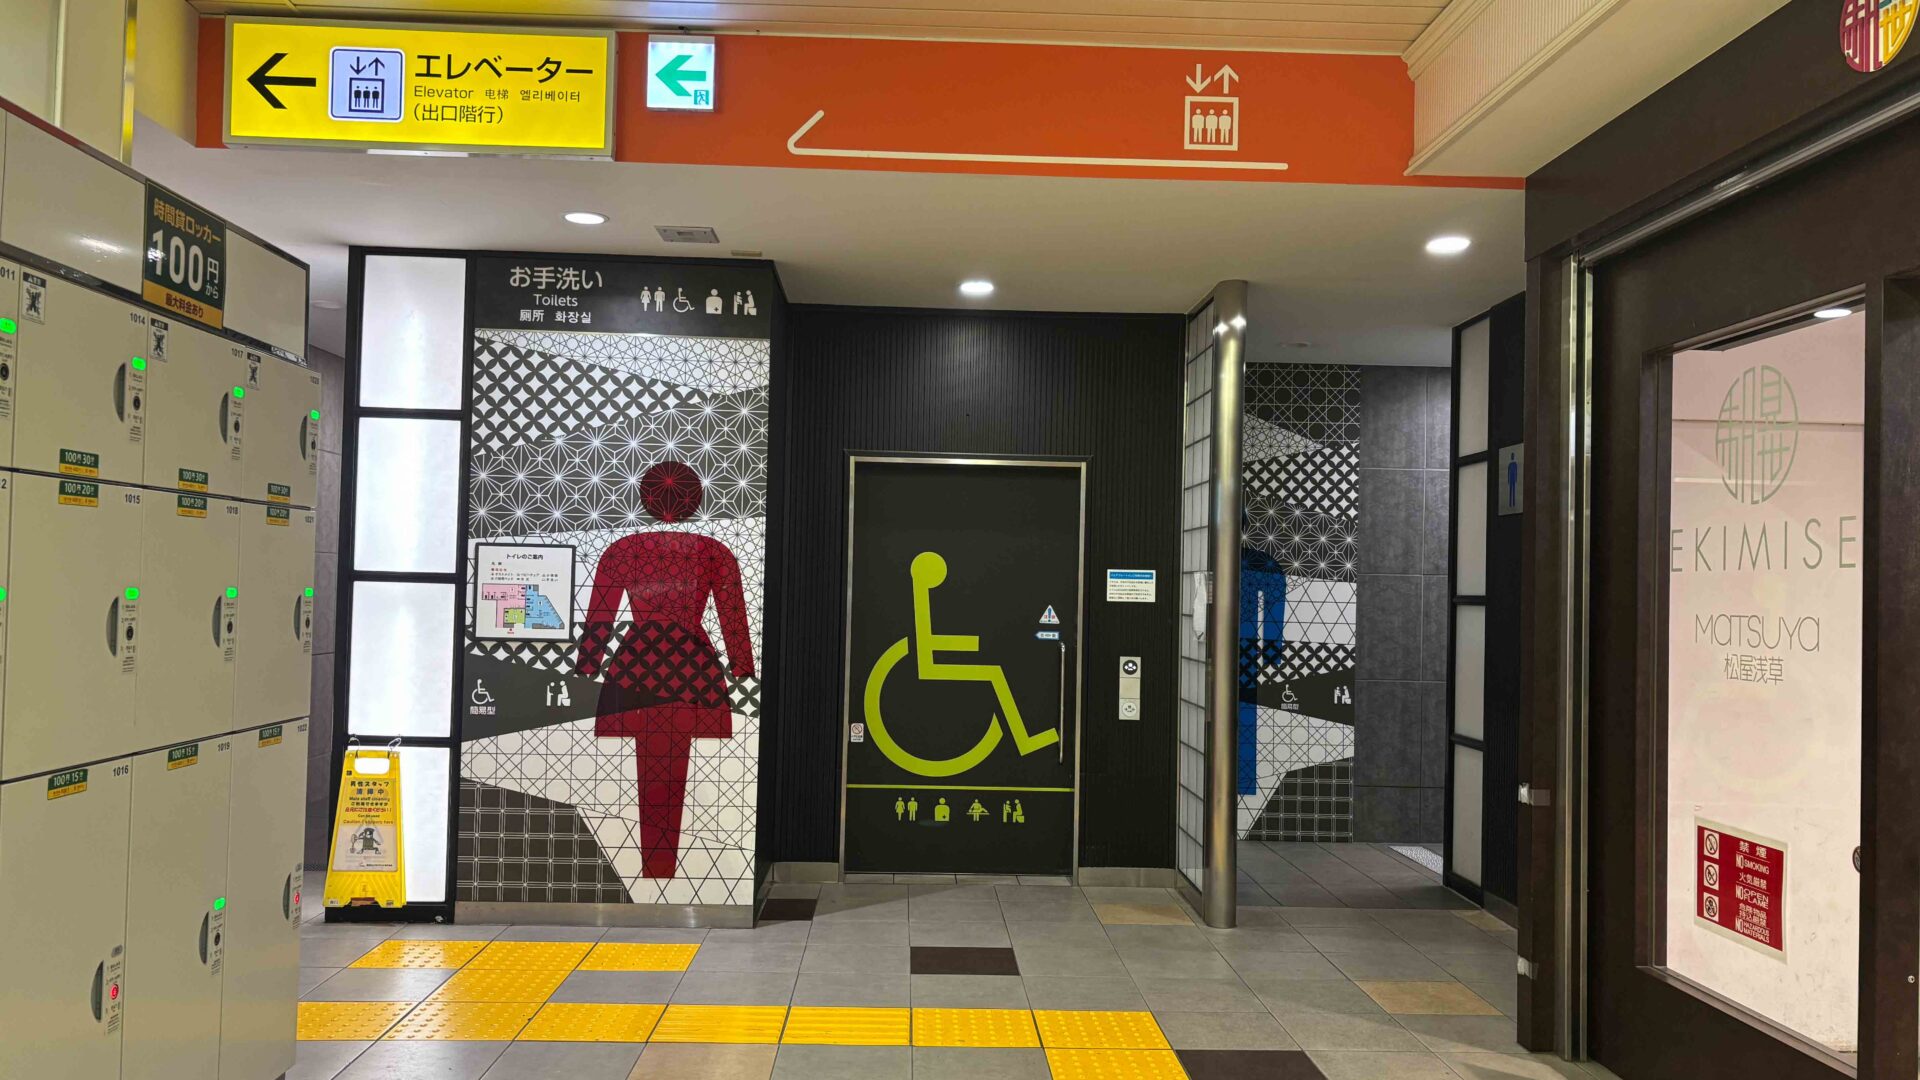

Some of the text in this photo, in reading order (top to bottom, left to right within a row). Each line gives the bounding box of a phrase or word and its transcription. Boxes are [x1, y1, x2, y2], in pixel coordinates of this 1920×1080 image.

[415, 54, 593, 83] エレベーター
[414, 86, 474, 99] Elevator
[485, 89, 509, 100] 电梯
[519, 89, 581, 102] 엘리베이터
[413, 103, 504, 124] （出口階行）
[153, 198, 222, 244] 時間貸ロッカー
[0, 266, 15, 281] 011
[509, 266, 603, 291] お手洗い
[533, 294, 578, 307] Toilets
[130, 312, 145, 325] 1014
[554, 312, 592, 324] 화장실
[231, 348, 243, 358] 1017
[125, 494, 141, 504] 1015
[1671, 516, 1857, 572] EKIMISE
[1724, 653, 1784, 685] 松屋浅草
[218, 742, 230, 752] 1019
[112, 765, 129, 777] 1016
[1736, 853, 1770, 875] NO SMOKING
[1736, 884, 1769, 903] NO OPEN
[1744, 894, 1769, 910] FLAME
[1735, 916, 1744, 933] NO
